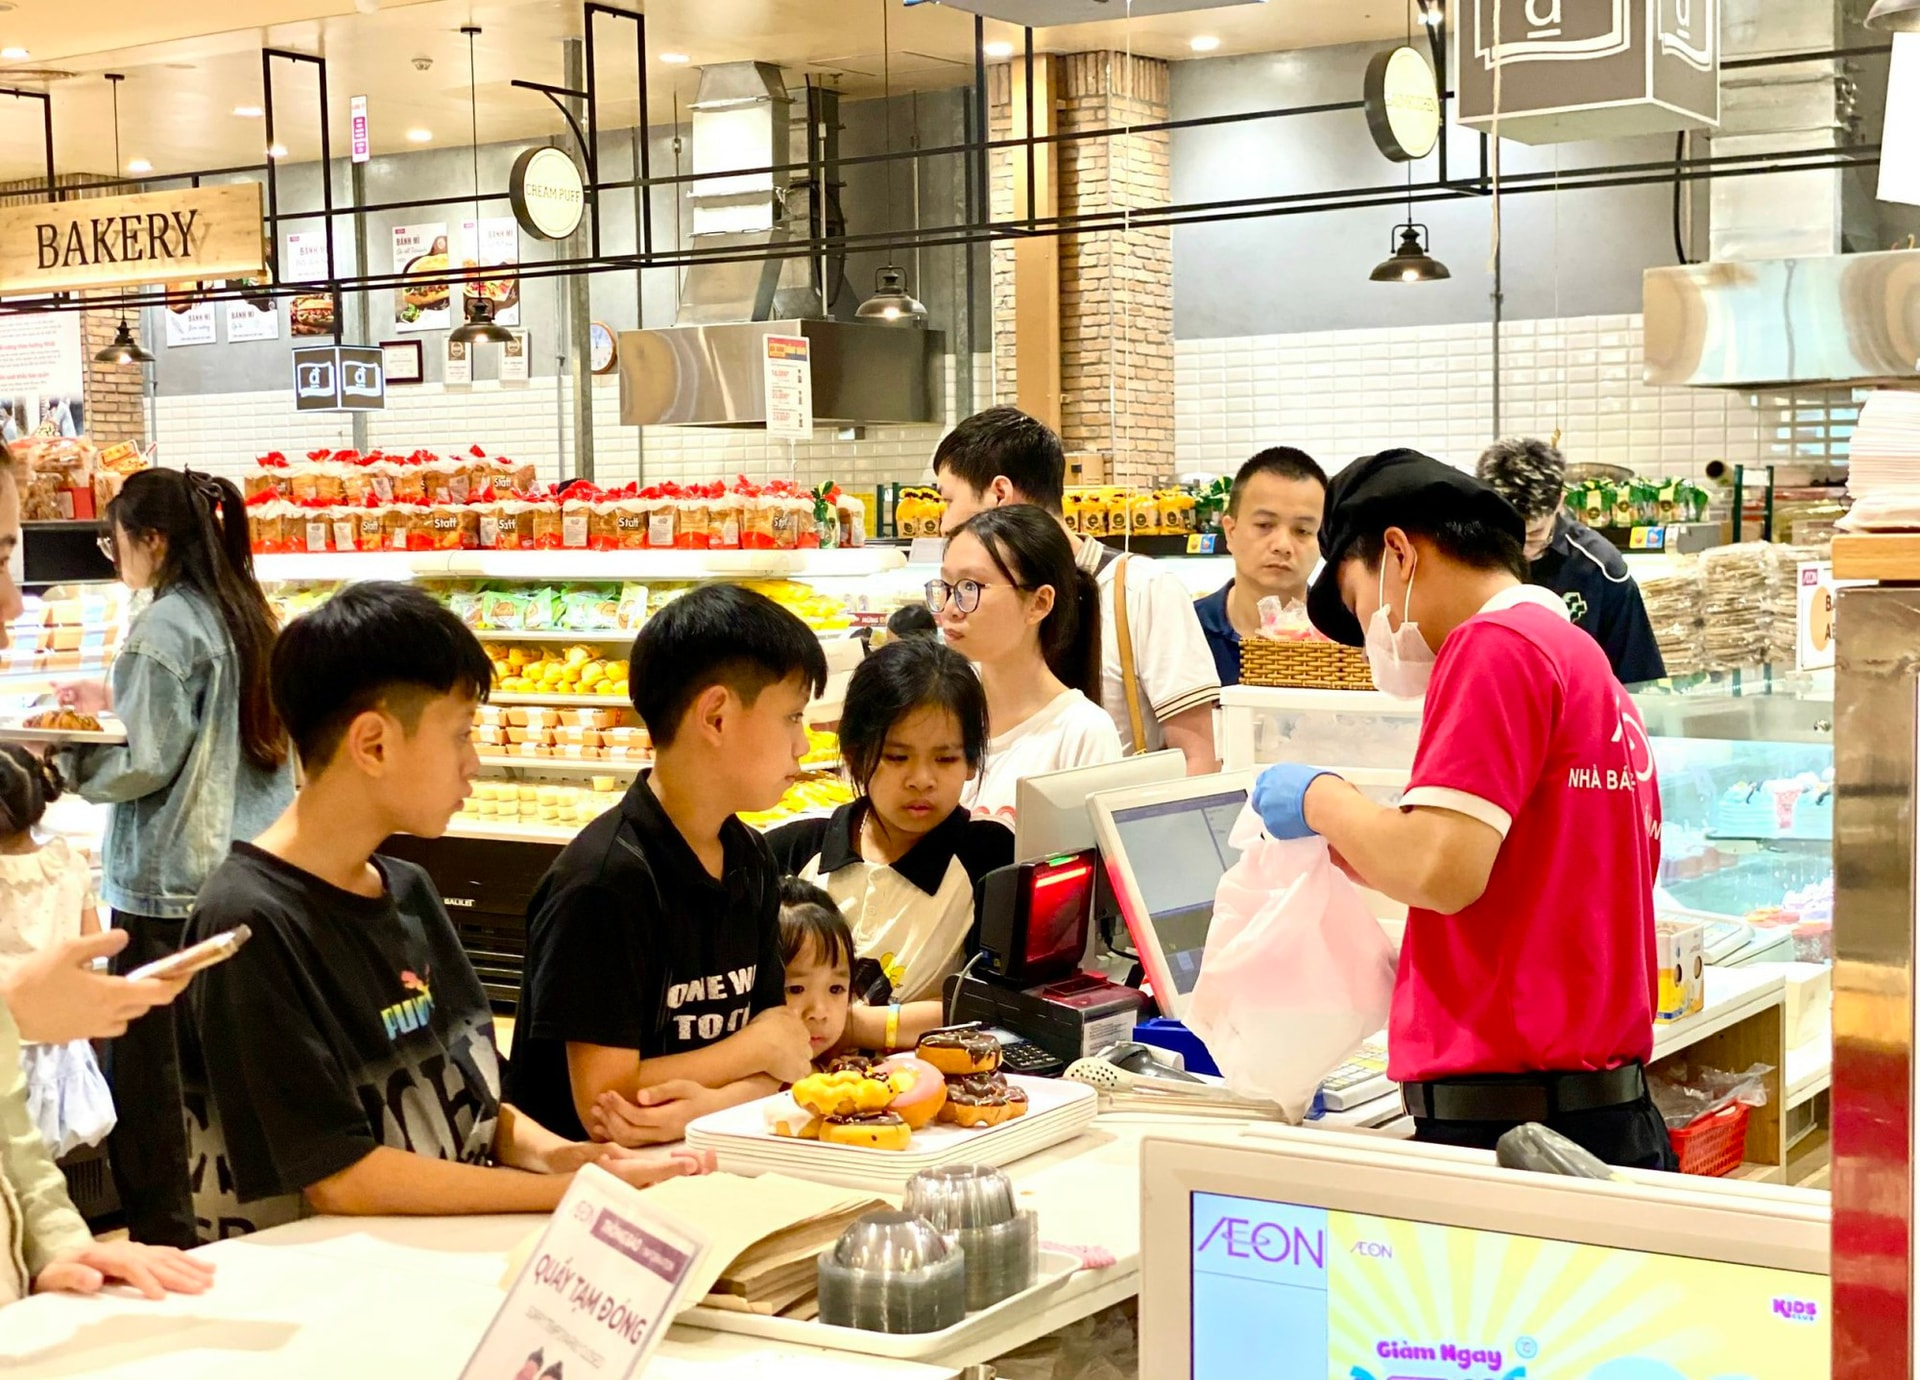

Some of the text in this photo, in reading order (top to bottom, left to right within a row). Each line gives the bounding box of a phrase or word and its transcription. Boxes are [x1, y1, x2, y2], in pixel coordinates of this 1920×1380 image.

[525, 183, 580, 202] CREAM PUFF
[35, 208, 198, 269] BAKERY
[434, 518, 457, 528] Staff
[618, 517, 639, 528] Staff
[1568, 763, 1602, 789] NHÀ
[667, 975, 728, 1009] ONE
[673, 1013, 724, 1040] TO
[1773, 1299, 1817, 1318] KIDS
[1440, 1343, 1503, 1372] Ngay
